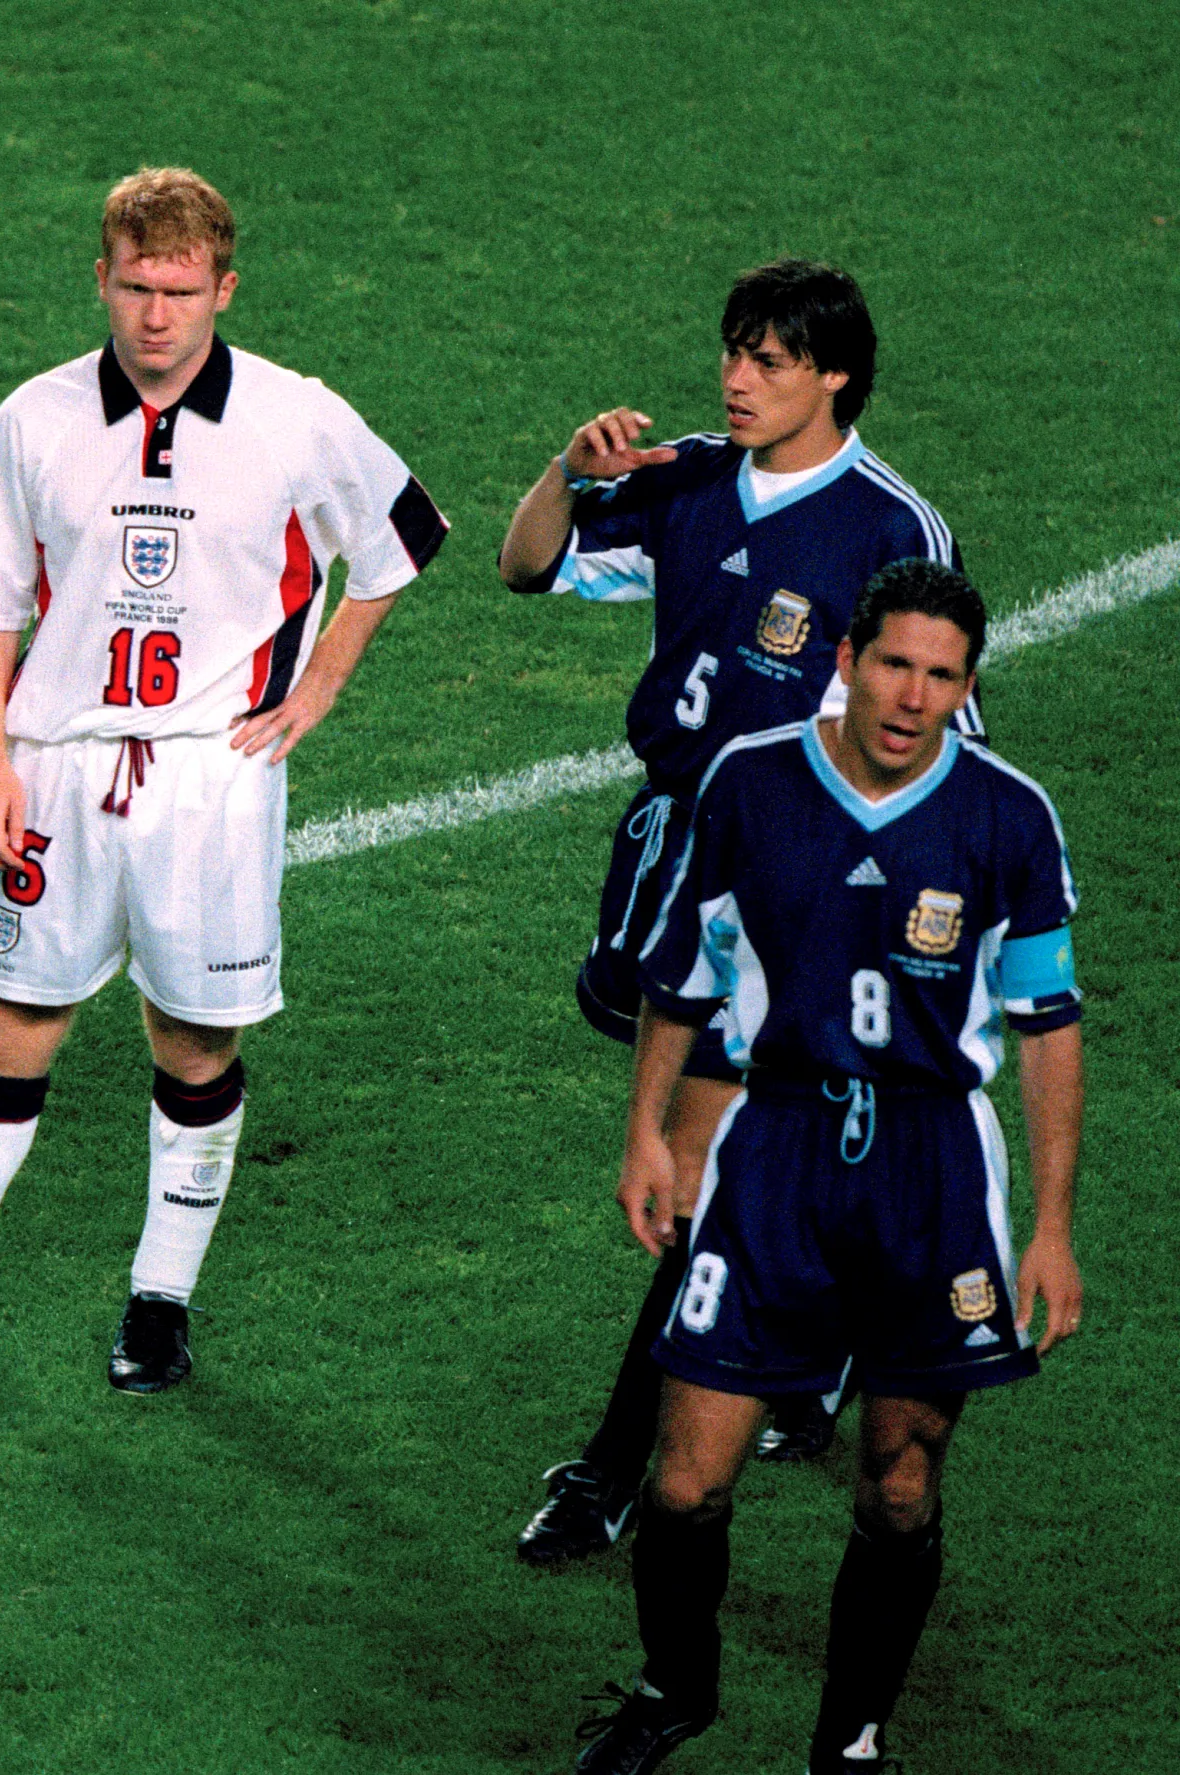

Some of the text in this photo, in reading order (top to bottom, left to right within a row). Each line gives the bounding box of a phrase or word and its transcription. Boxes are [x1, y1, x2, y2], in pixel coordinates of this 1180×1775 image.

[111, 504, 196, 521] UMBRO
[122, 590, 173, 602] ENGLAND
[105, 601, 188, 615] FIFA WORLD CUP
[114, 611, 153, 623] FRANCE
[103, 626, 182, 708] 16
[674, 651, 719, 730] 5
[207, 954, 271, 973] UMBRO
[851, 968, 892, 1049] 8
[163, 1190, 220, 1209] UMBRO
[680, 1251, 728, 1334] 8
